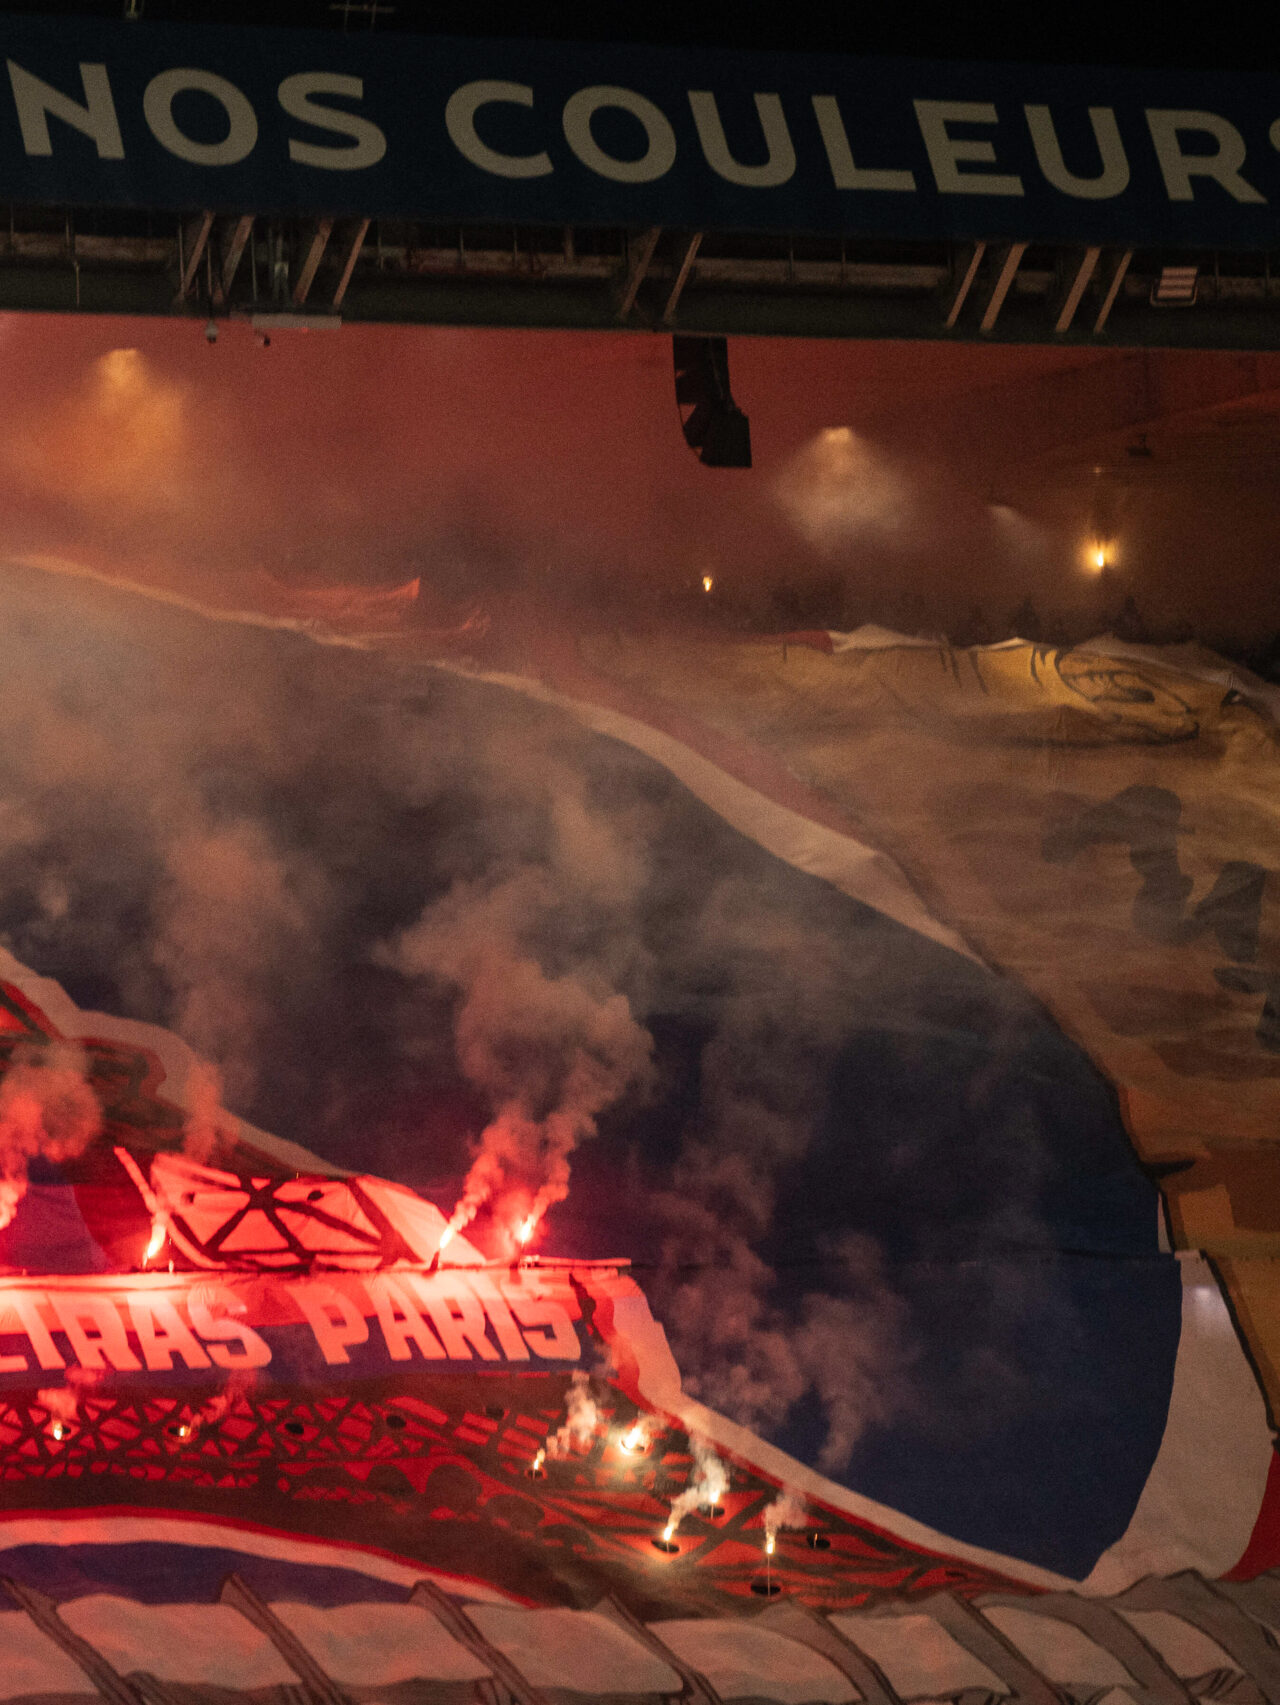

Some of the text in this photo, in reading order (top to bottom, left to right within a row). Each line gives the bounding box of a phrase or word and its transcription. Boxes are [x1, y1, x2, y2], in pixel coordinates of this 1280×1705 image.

[5, 58, 387, 170] NOS
[444, 78, 1280, 204] COULEUR
[285, 1270, 581, 1366] PARIS
